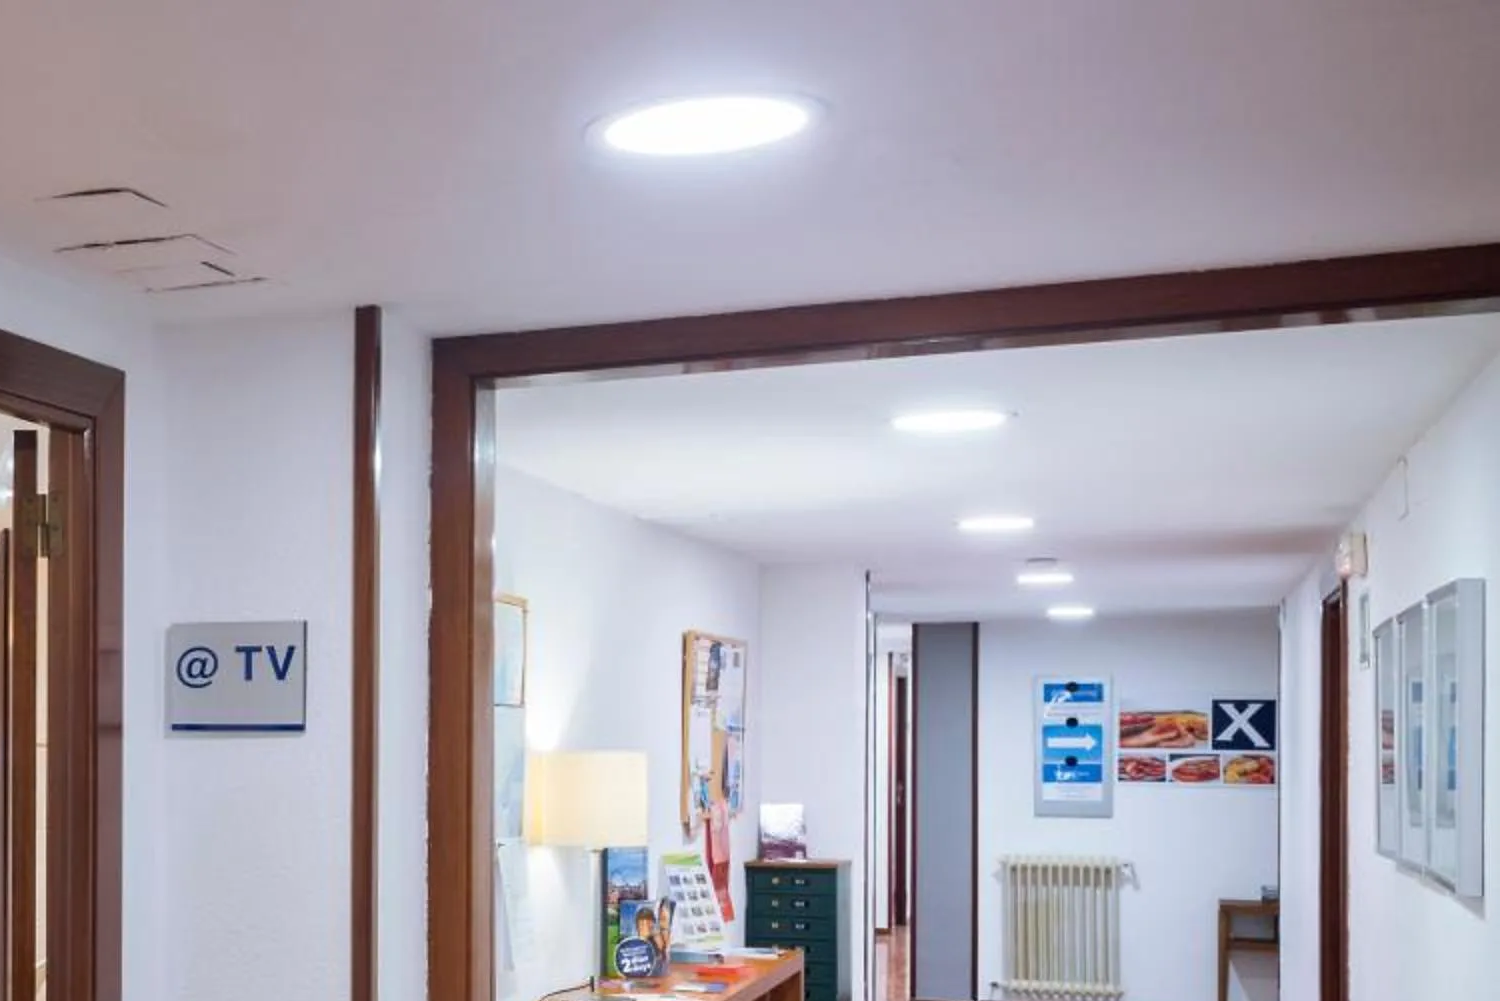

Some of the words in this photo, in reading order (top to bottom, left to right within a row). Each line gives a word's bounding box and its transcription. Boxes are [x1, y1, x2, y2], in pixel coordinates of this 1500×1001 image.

[176, 646, 219, 689] @
[235, 645, 296, 681] TV
[1215, 703, 1271, 748] X
